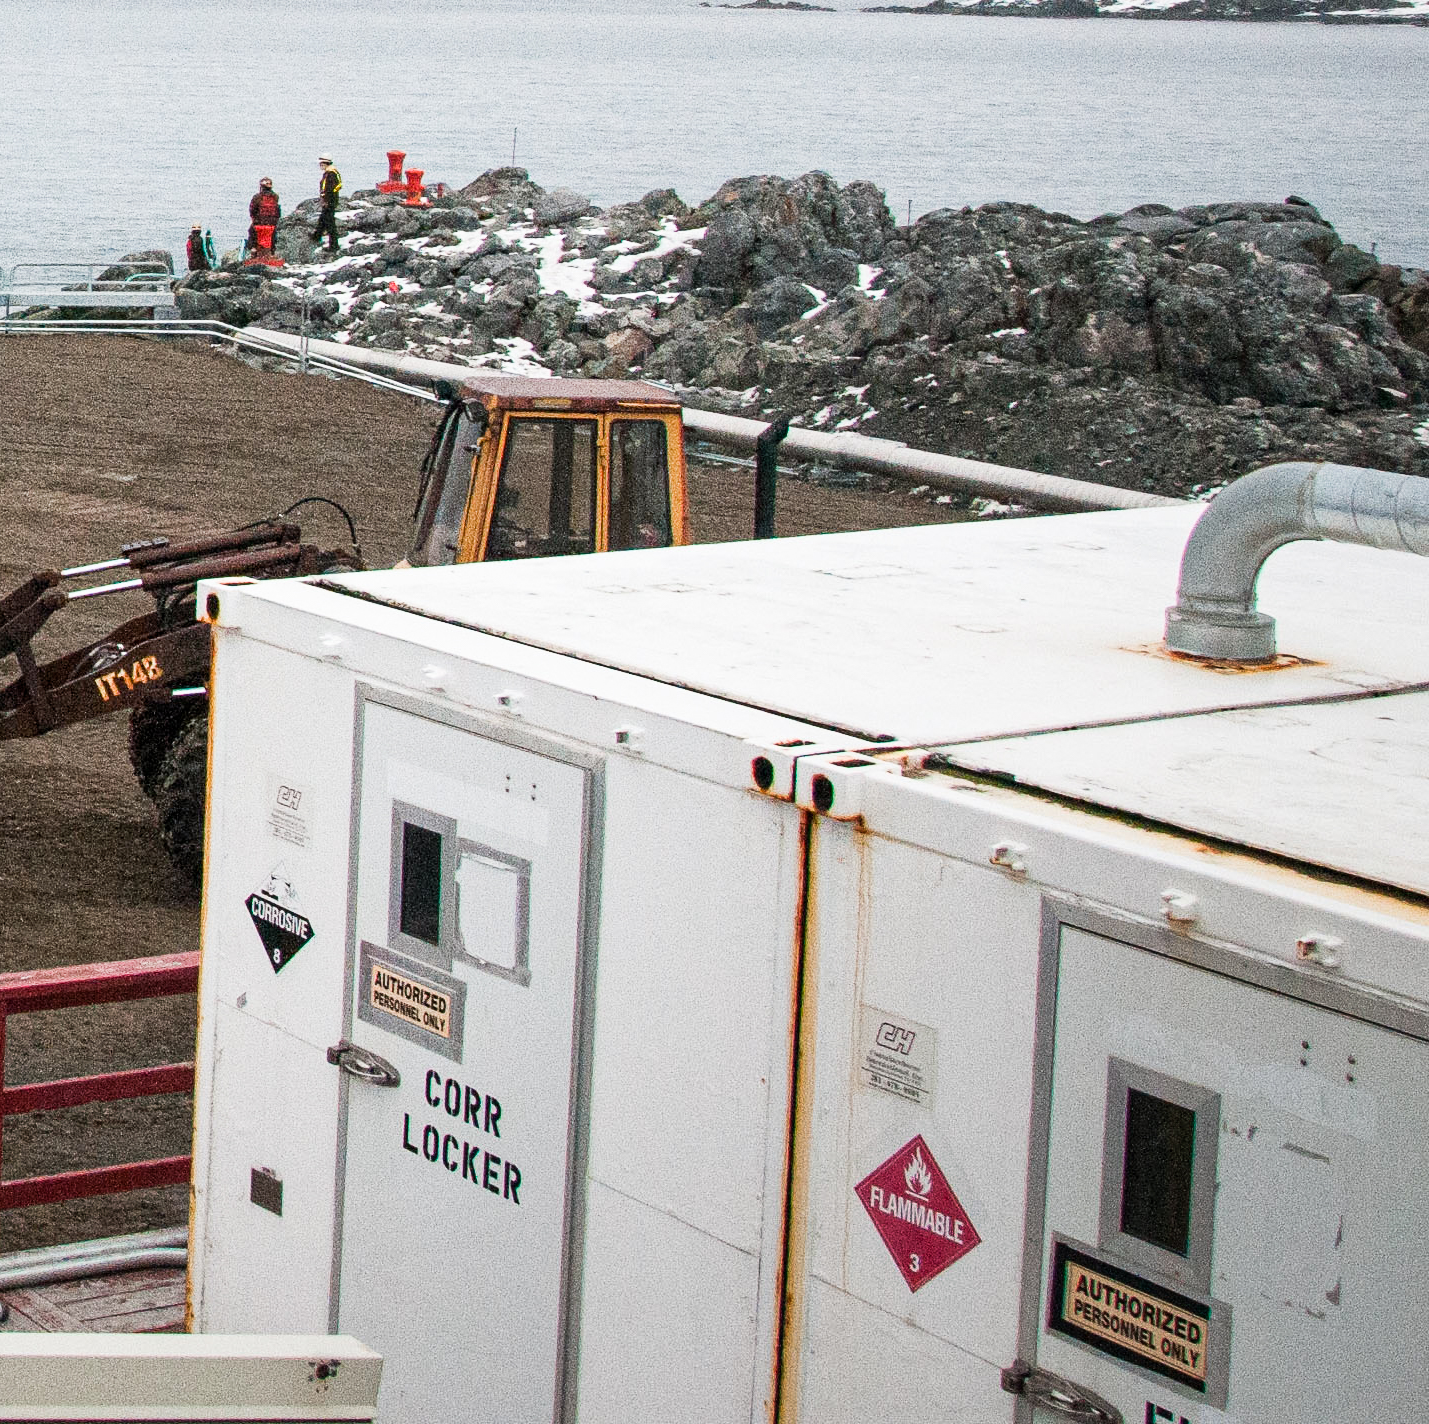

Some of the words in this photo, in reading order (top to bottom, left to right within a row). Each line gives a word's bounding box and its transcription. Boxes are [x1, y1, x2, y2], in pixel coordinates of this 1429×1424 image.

[251, 897, 309, 940] CORROSIVE
[273, 948, 282, 964] 8
[373, 990, 422, 1023] PERSONNEL
[423, 1011, 446, 1033] ONLY
[374, 970, 447, 1014] AUTHORIZED
[425, 1069, 503, 1139] CORR
[402, 1112, 523, 1206] LOCKER
[870, 1185, 964, 1245] FLAMMABLE
[909, 1253, 920, 1273] 3
[1074, 1298, 1156, 1351] PERSONNEL
[1161, 1337, 1201, 1369] ONLY
[1075, 1274, 1201, 1345] AUTHORIZED
